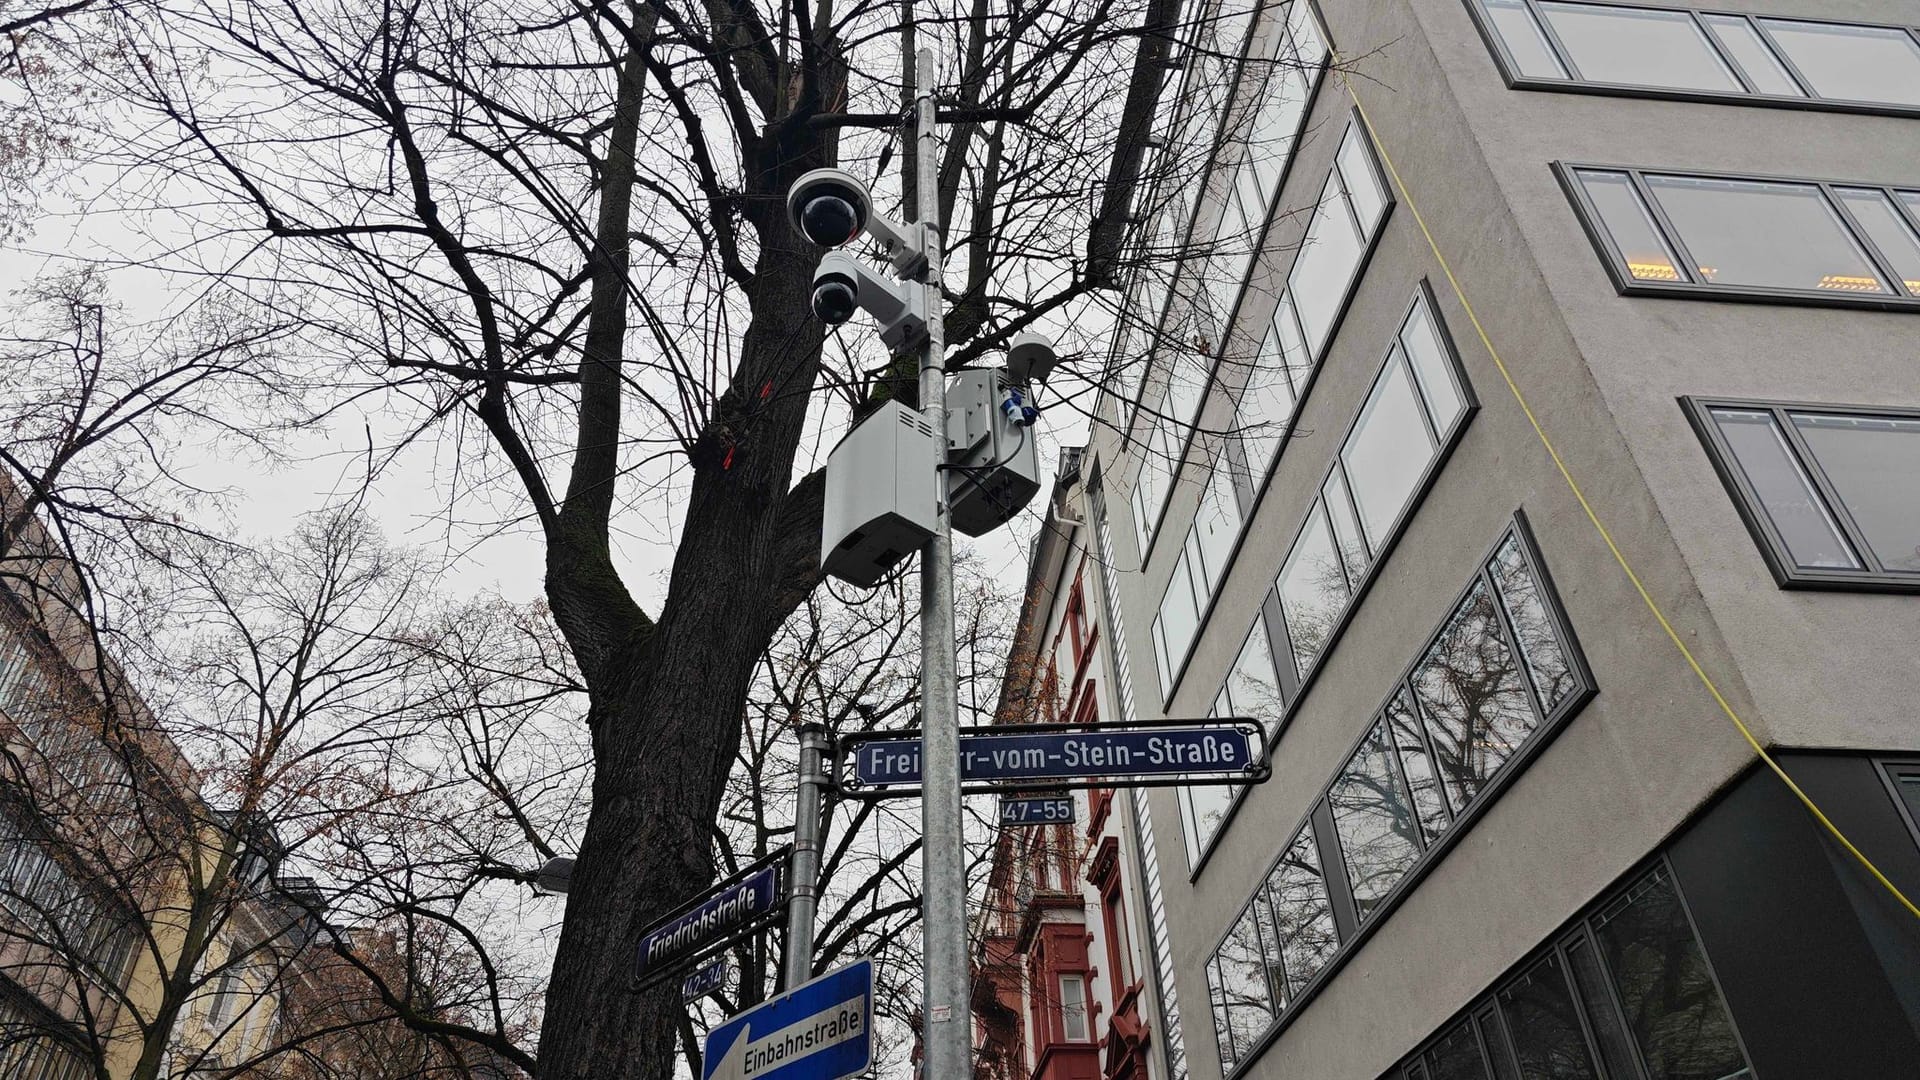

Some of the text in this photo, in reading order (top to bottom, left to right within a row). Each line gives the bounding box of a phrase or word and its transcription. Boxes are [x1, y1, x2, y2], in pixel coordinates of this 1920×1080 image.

[871, 735, 1235, 775] Freir-vom-Stein-Straße
[1004, 800, 1070, 821] 47-55
[647, 886, 755, 965] Friedrichstraße
[686, 963, 721, 998] 42-34
[743, 1010, 859, 1075] Einbahnstraße
